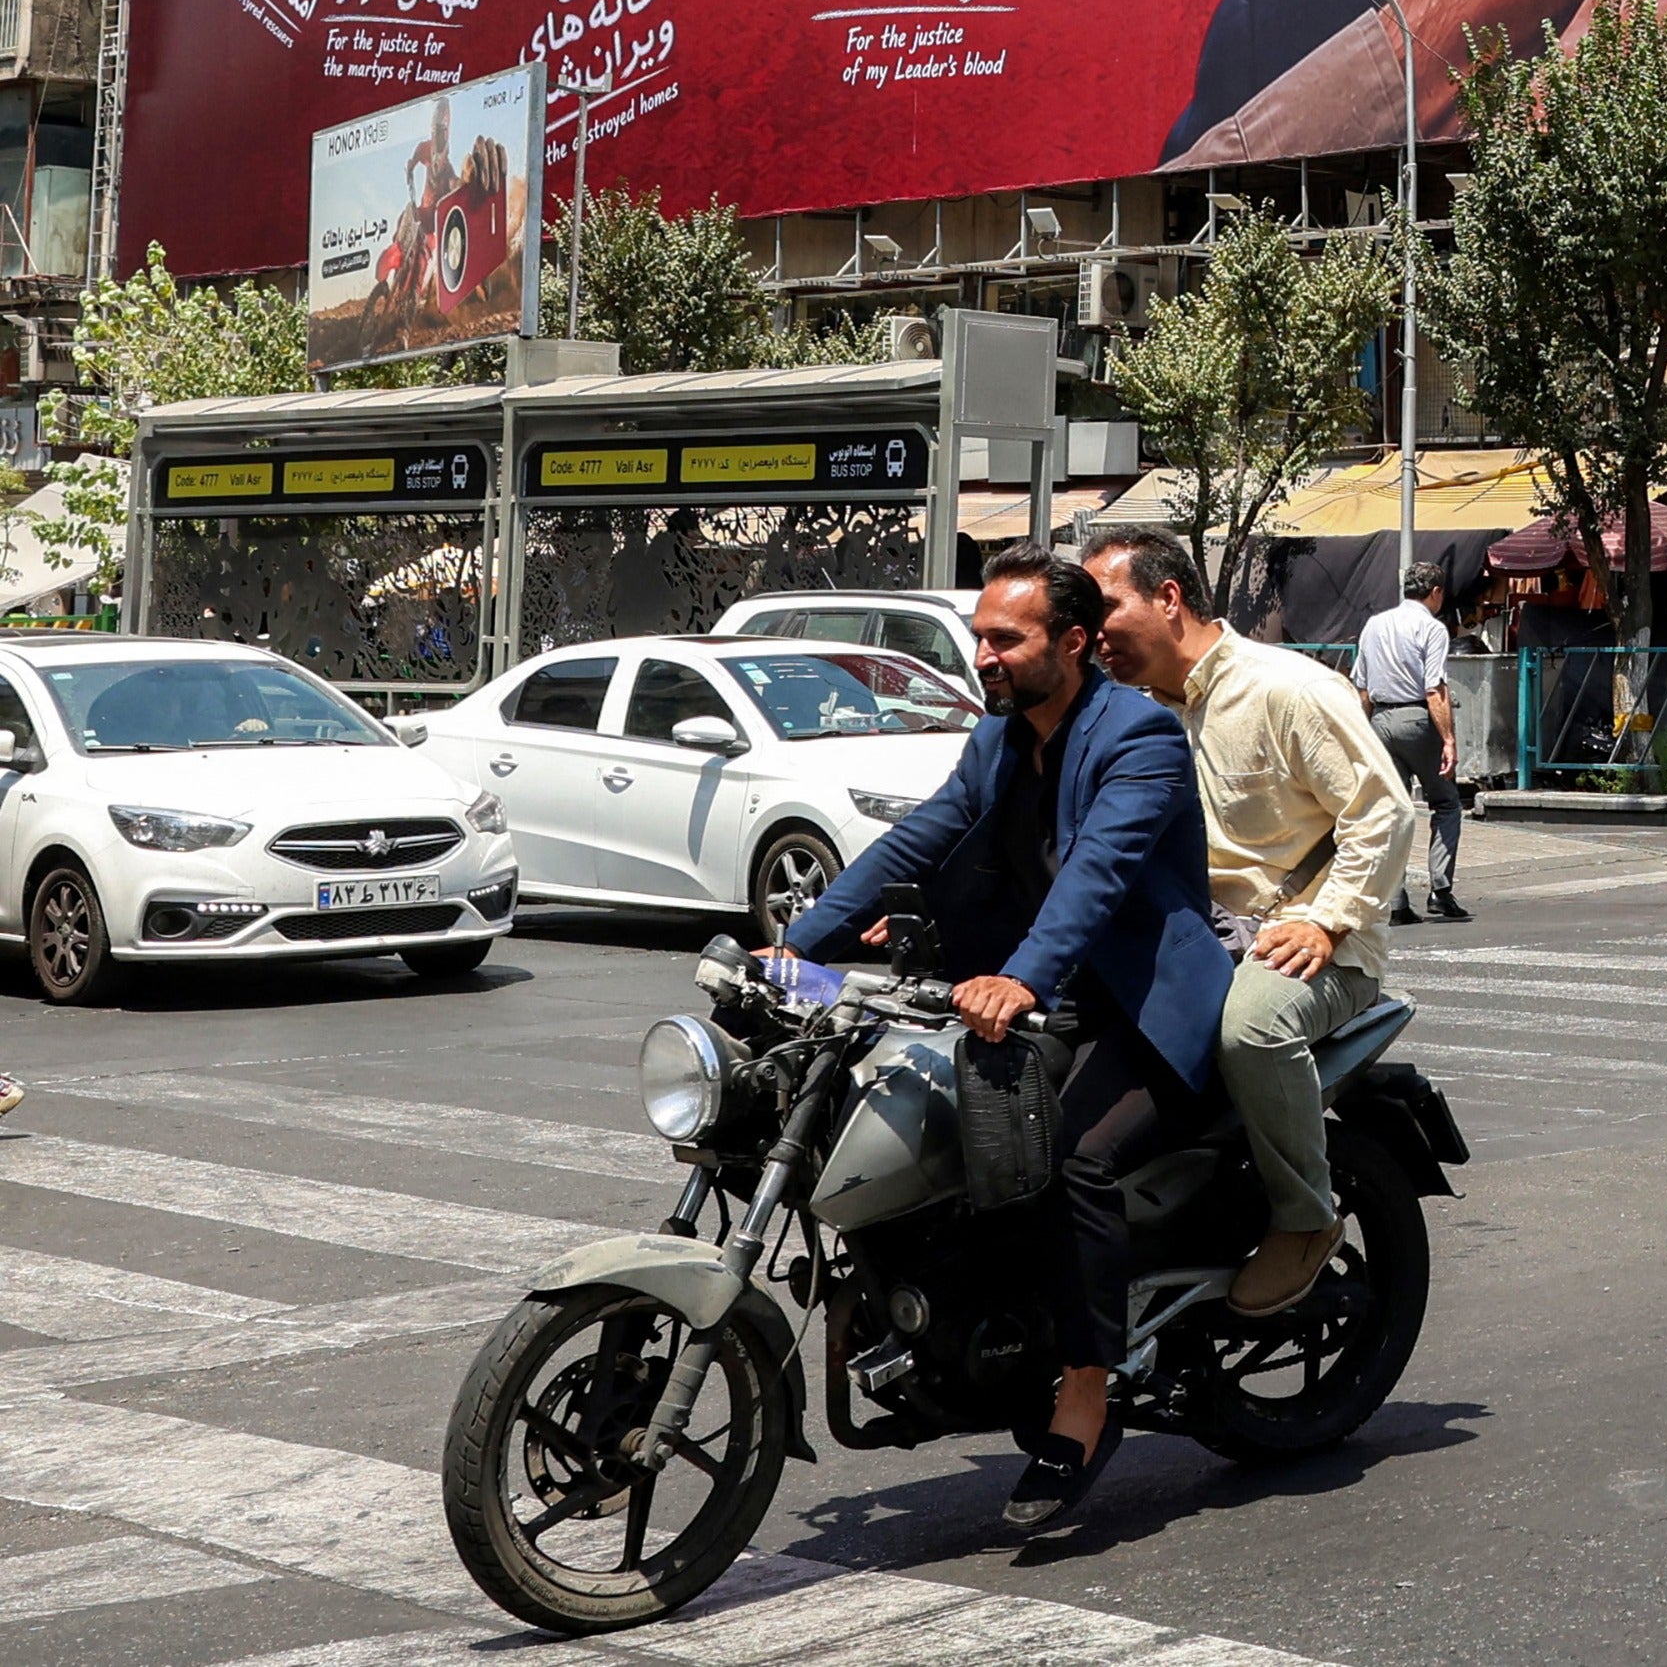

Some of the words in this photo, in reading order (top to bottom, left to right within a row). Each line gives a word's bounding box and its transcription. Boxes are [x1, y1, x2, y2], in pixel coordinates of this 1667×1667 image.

[327, 28, 349, 50] For
[353, 29, 373, 51] the
[375, 32, 418, 58] justice
[424, 32, 445, 56] for
[847, 26, 874, 53] For
[880, 24, 907, 49] the
[908, 22, 964, 54] justice
[323, 55, 343, 77] the
[347, 59, 394, 85] martyrs
[397, 60, 414, 85] of
[415, 62, 462, 84] Lamerd
[843, 56, 863, 85] of
[865, 61, 891, 88] my
[894, 54, 957, 80] Leader's
[963, 49, 1006, 76] blood
[483, 91, 507, 109] HONOR
[328, 129, 361, 157] HONOR
[550, 459, 575, 474] Code:
[579, 459, 603, 474] 4777
[615, 459, 634, 474] Vali
[635, 459, 654, 473] Asr
[830, 463, 850, 479] BUS
[849, 463, 873, 477] STOP
[175, 474, 197, 487] Code:
[406, 477, 421, 489] BUS
[422, 476, 441, 489] STOP
